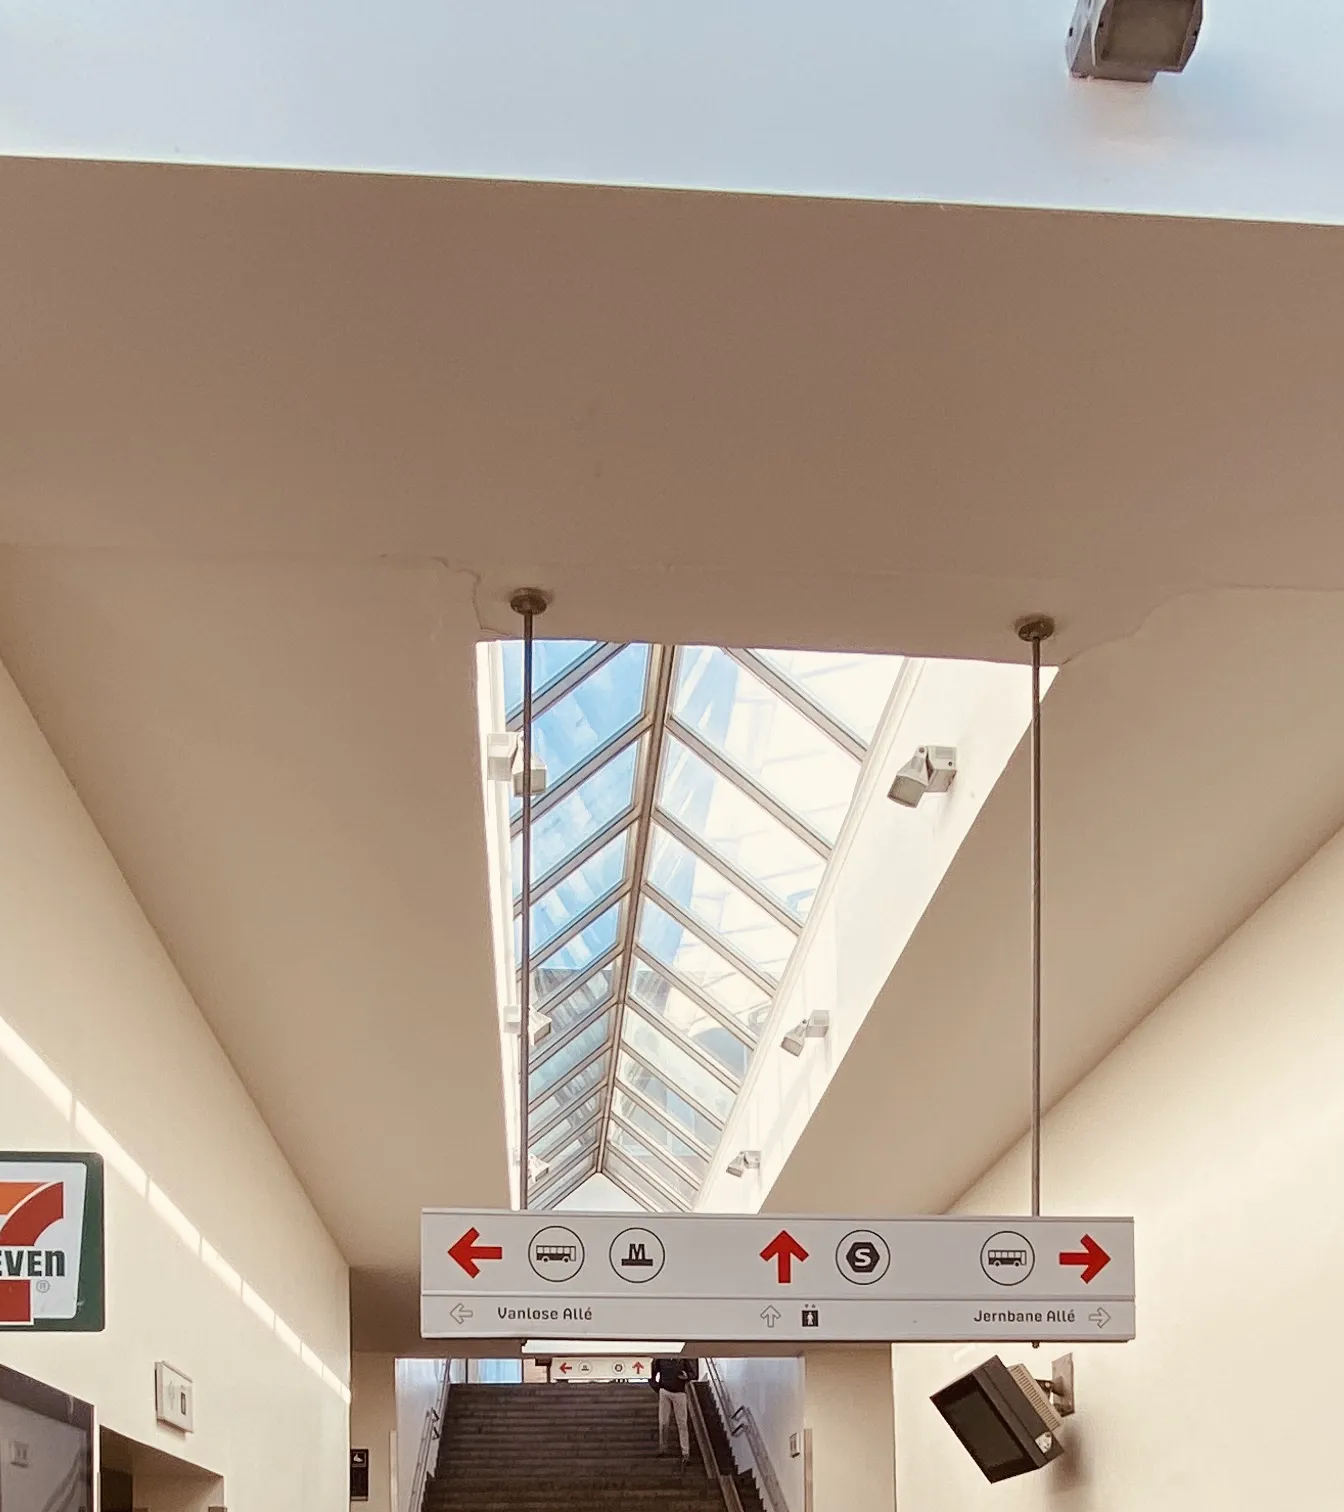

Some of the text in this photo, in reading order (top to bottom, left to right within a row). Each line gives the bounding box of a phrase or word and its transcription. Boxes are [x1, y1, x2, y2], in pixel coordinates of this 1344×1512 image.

[563, 1306, 592, 1320] Allé
[973, 1304, 1075, 1323] Jernbane Allé
